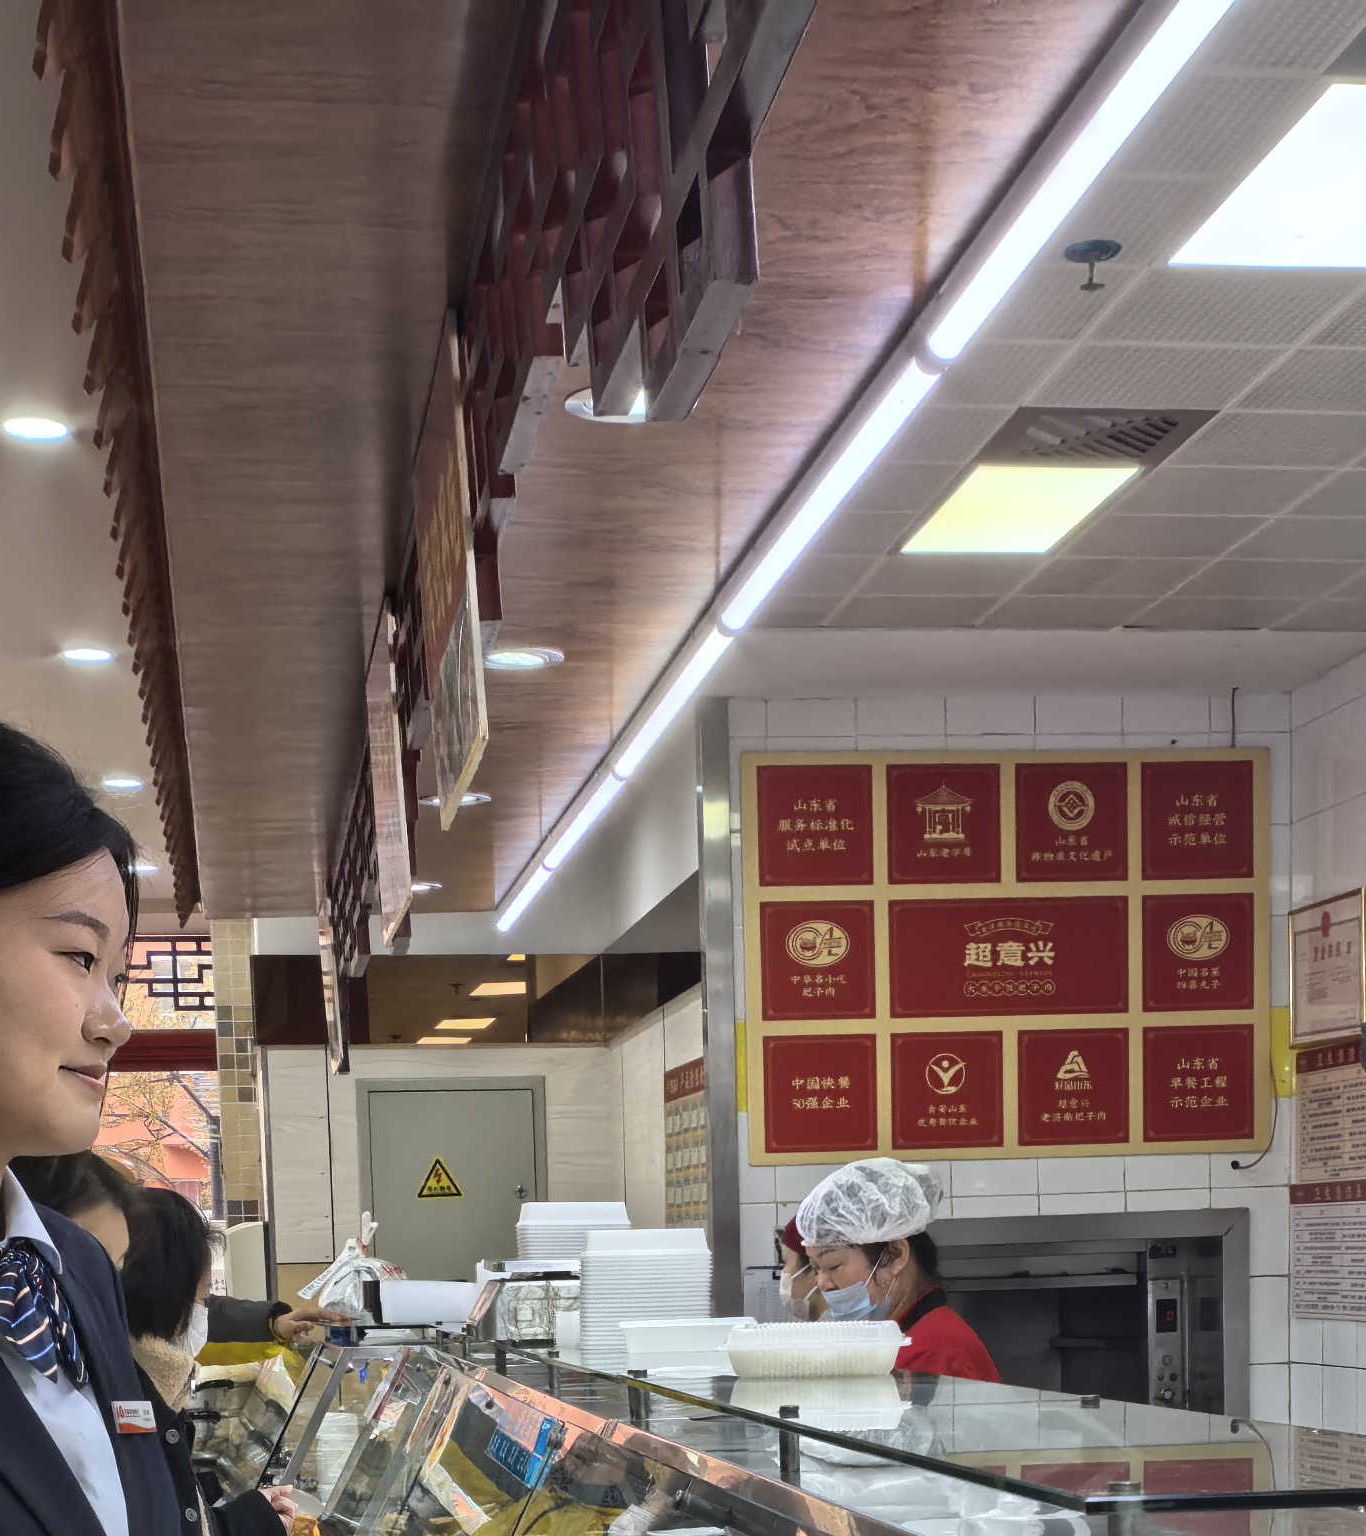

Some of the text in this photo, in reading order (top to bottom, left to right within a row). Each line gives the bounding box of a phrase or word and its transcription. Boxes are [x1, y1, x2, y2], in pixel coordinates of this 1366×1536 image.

[793, 798, 837, 812] 山东省
[1175, 793, 1219, 807] 山东省
[778, 818, 854, 832] 服务标准化
[1168, 813, 1227, 827] 诚信经营
[787, 838, 846, 852] 试点单位
[1055, 836, 1089, 846] 山东省
[1168, 833, 1227, 846] 示范单位
[964, 941, 1055, 967] 超意兴
[1177, 979, 1221, 990] 四喜丸子
[1177, 1057, 1220, 1070] 山东省
[792, 1076, 850, 1090] 中国快餐
[1170, 1076, 1227, 1089] 早餐工程
[792, 1096, 850, 1110] 50强企业
[1170, 1095, 1229, 1108] 示范企业
